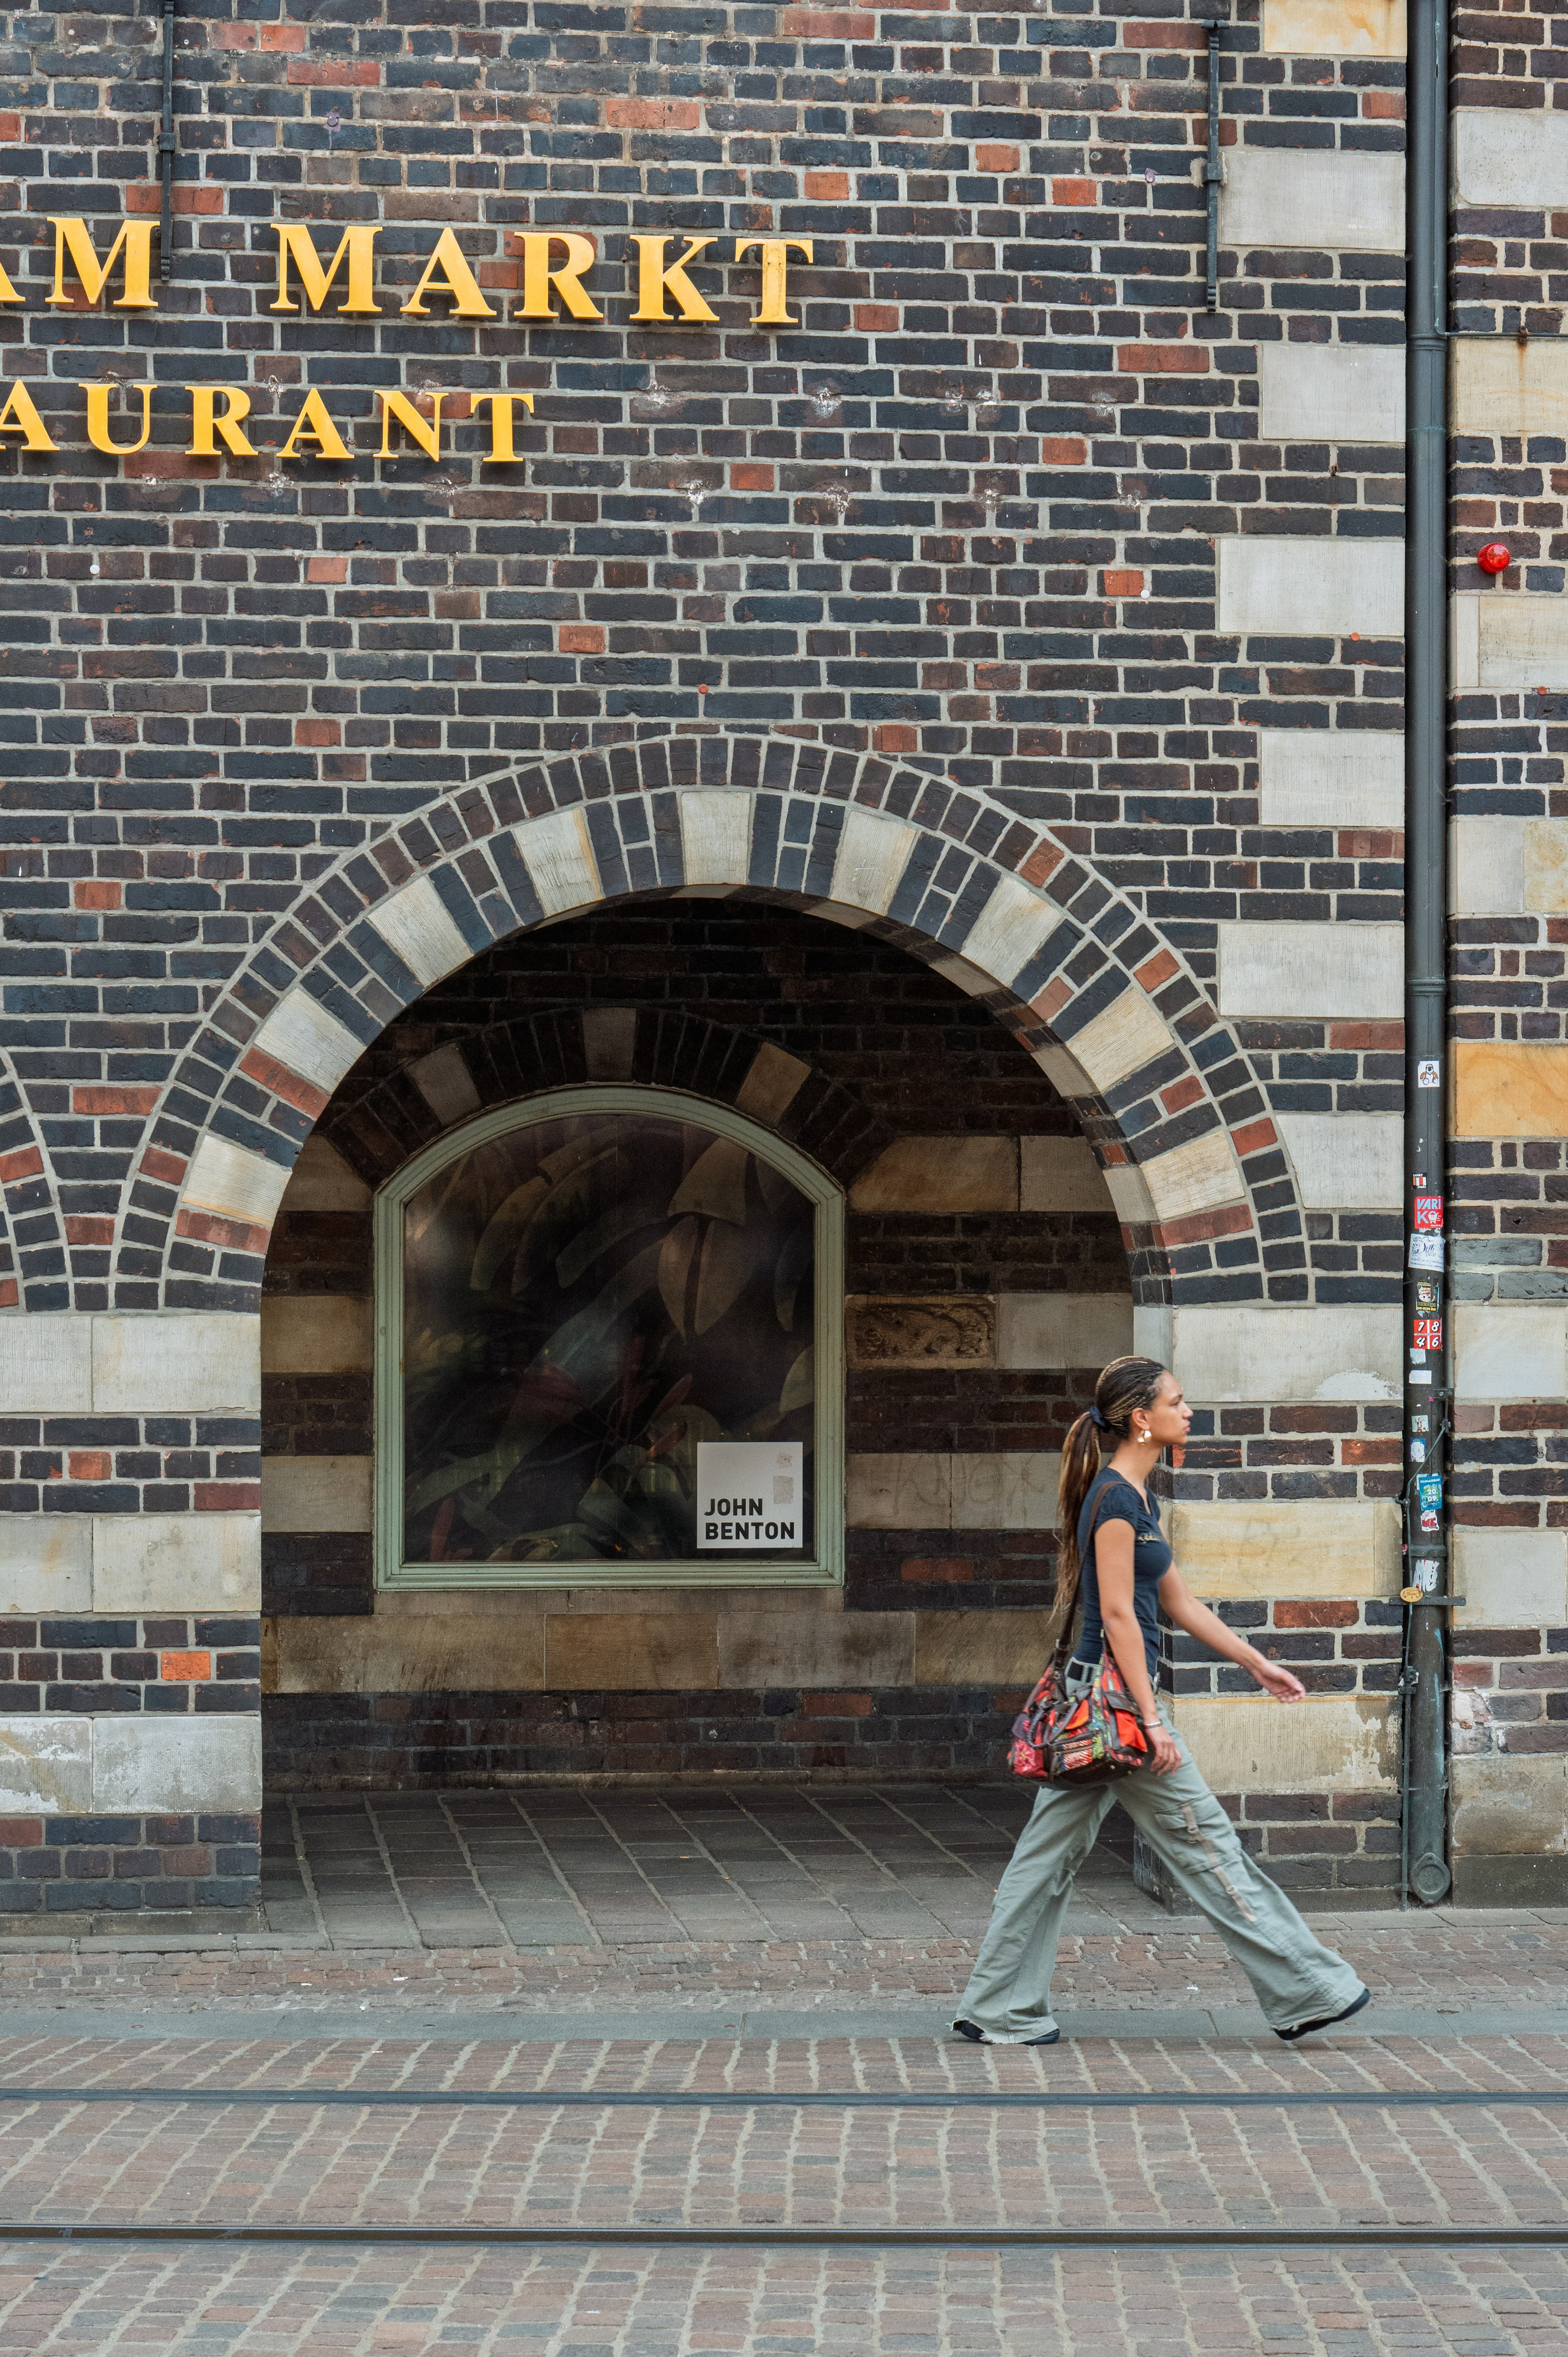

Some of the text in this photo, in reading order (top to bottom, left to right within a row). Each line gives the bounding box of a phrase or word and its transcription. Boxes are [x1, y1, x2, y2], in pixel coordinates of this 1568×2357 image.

[0, 217, 813, 323] M MARKT
[0, 379, 534, 463] AURANT
[704, 1499, 763, 1516] JOHN
[705, 1522, 794, 1540] BENTON
